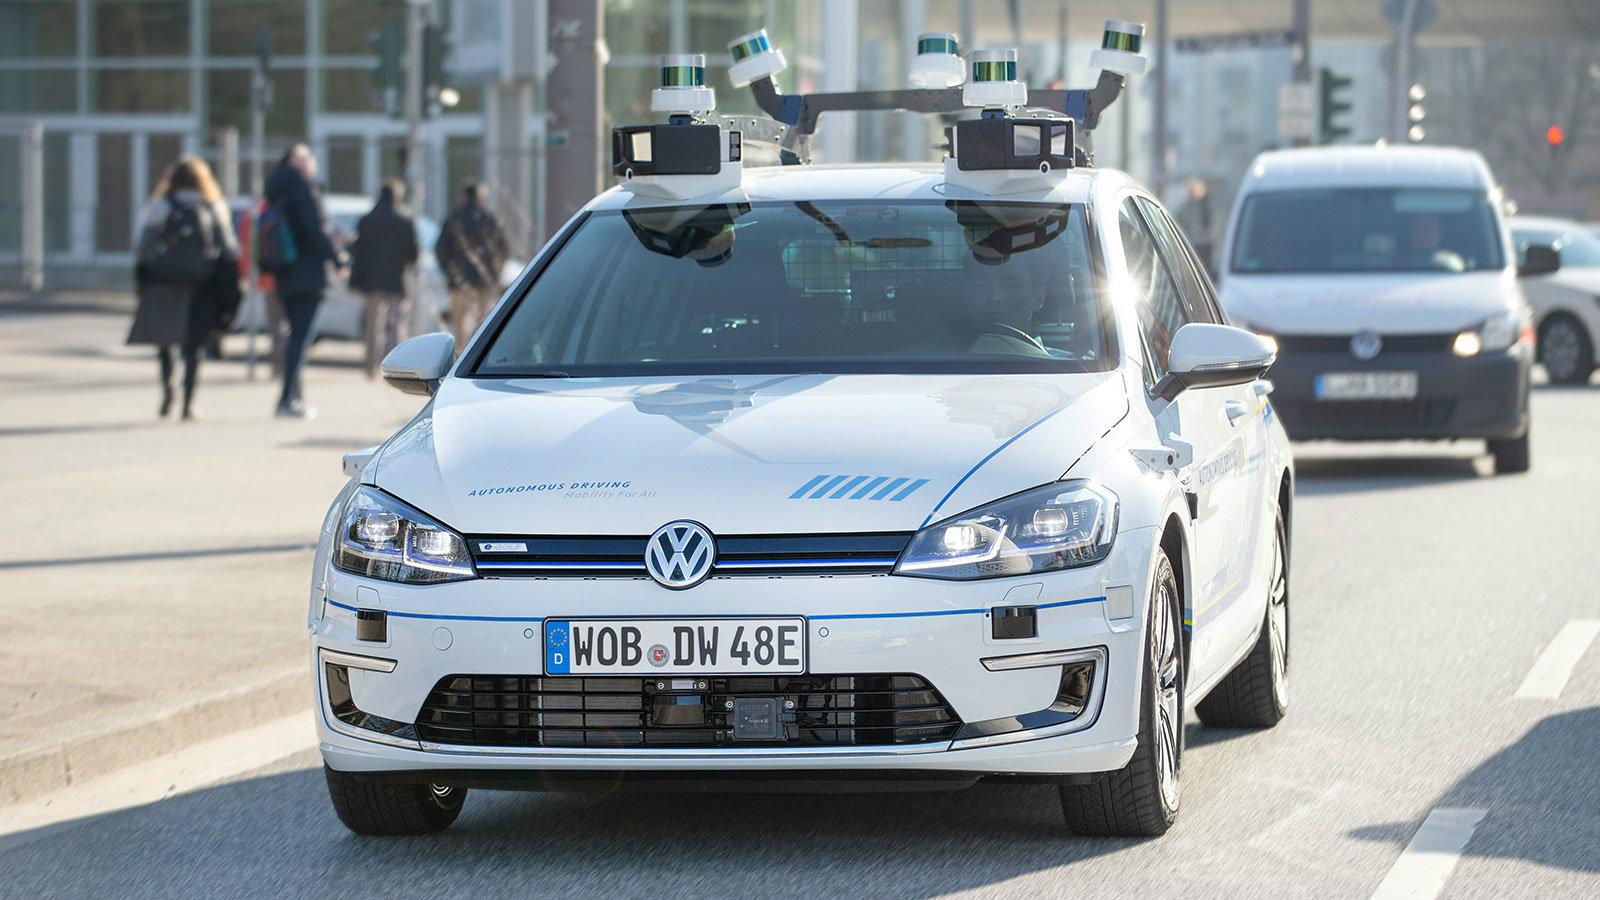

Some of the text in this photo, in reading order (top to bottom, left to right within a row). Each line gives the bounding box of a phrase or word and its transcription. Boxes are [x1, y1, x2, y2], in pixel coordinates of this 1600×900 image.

[468, 481, 632, 497] AUTONOMOUS DRIVING
[563, 490, 657, 500] Mobility For All
[647, 522, 714, 587] VW
[572, 625, 643, 667] WOB
[672, 625, 720, 667] DW
[729, 625, 801, 666] 48E
[553, 652, 564, 665] D
